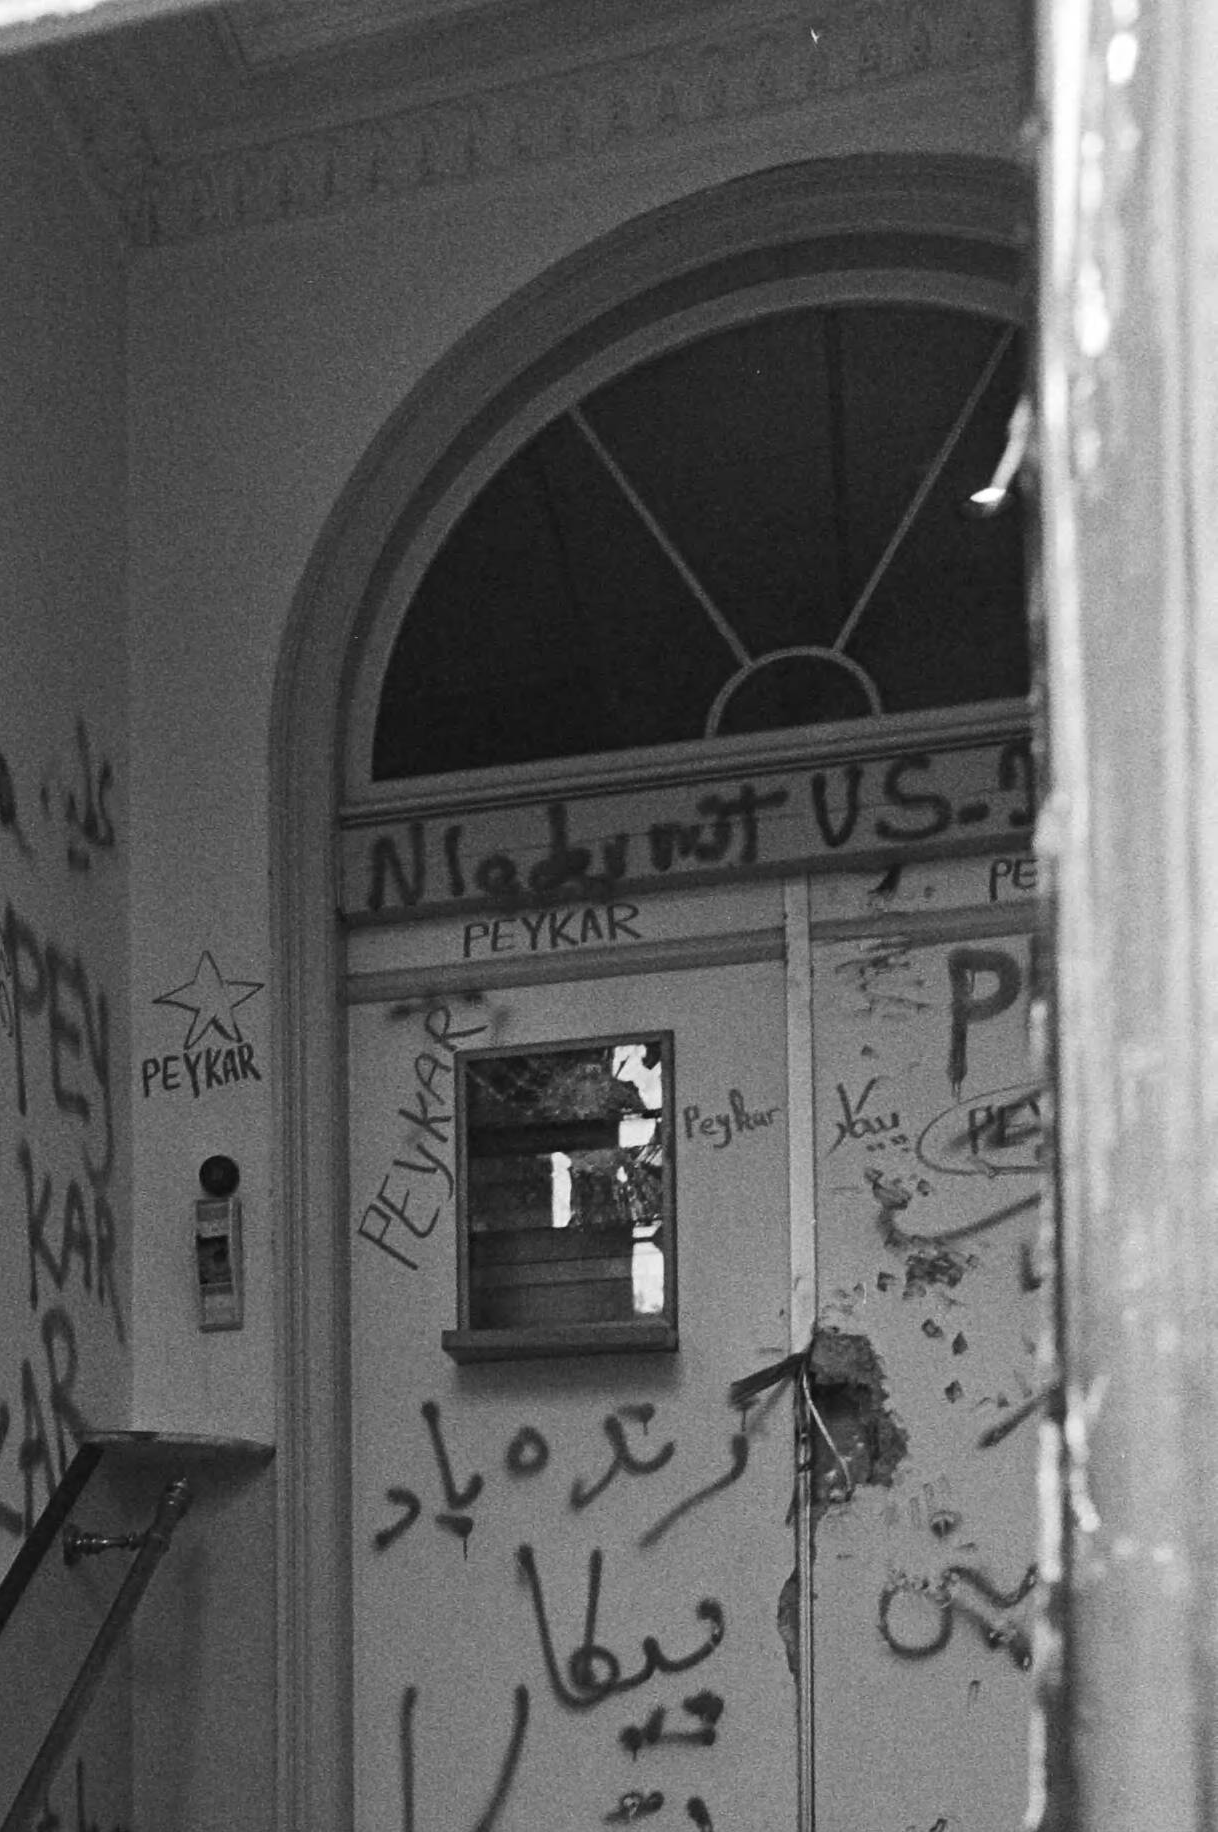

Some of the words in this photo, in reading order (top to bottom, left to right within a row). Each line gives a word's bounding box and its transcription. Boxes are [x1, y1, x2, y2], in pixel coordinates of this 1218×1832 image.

[463, 903, 643, 958] PEYKAR
[142, 1043, 262, 1099] PEYKAR
[357, 1006, 488, 1270] PEYKAR
[684, 1088, 780, 1148] Peykar
